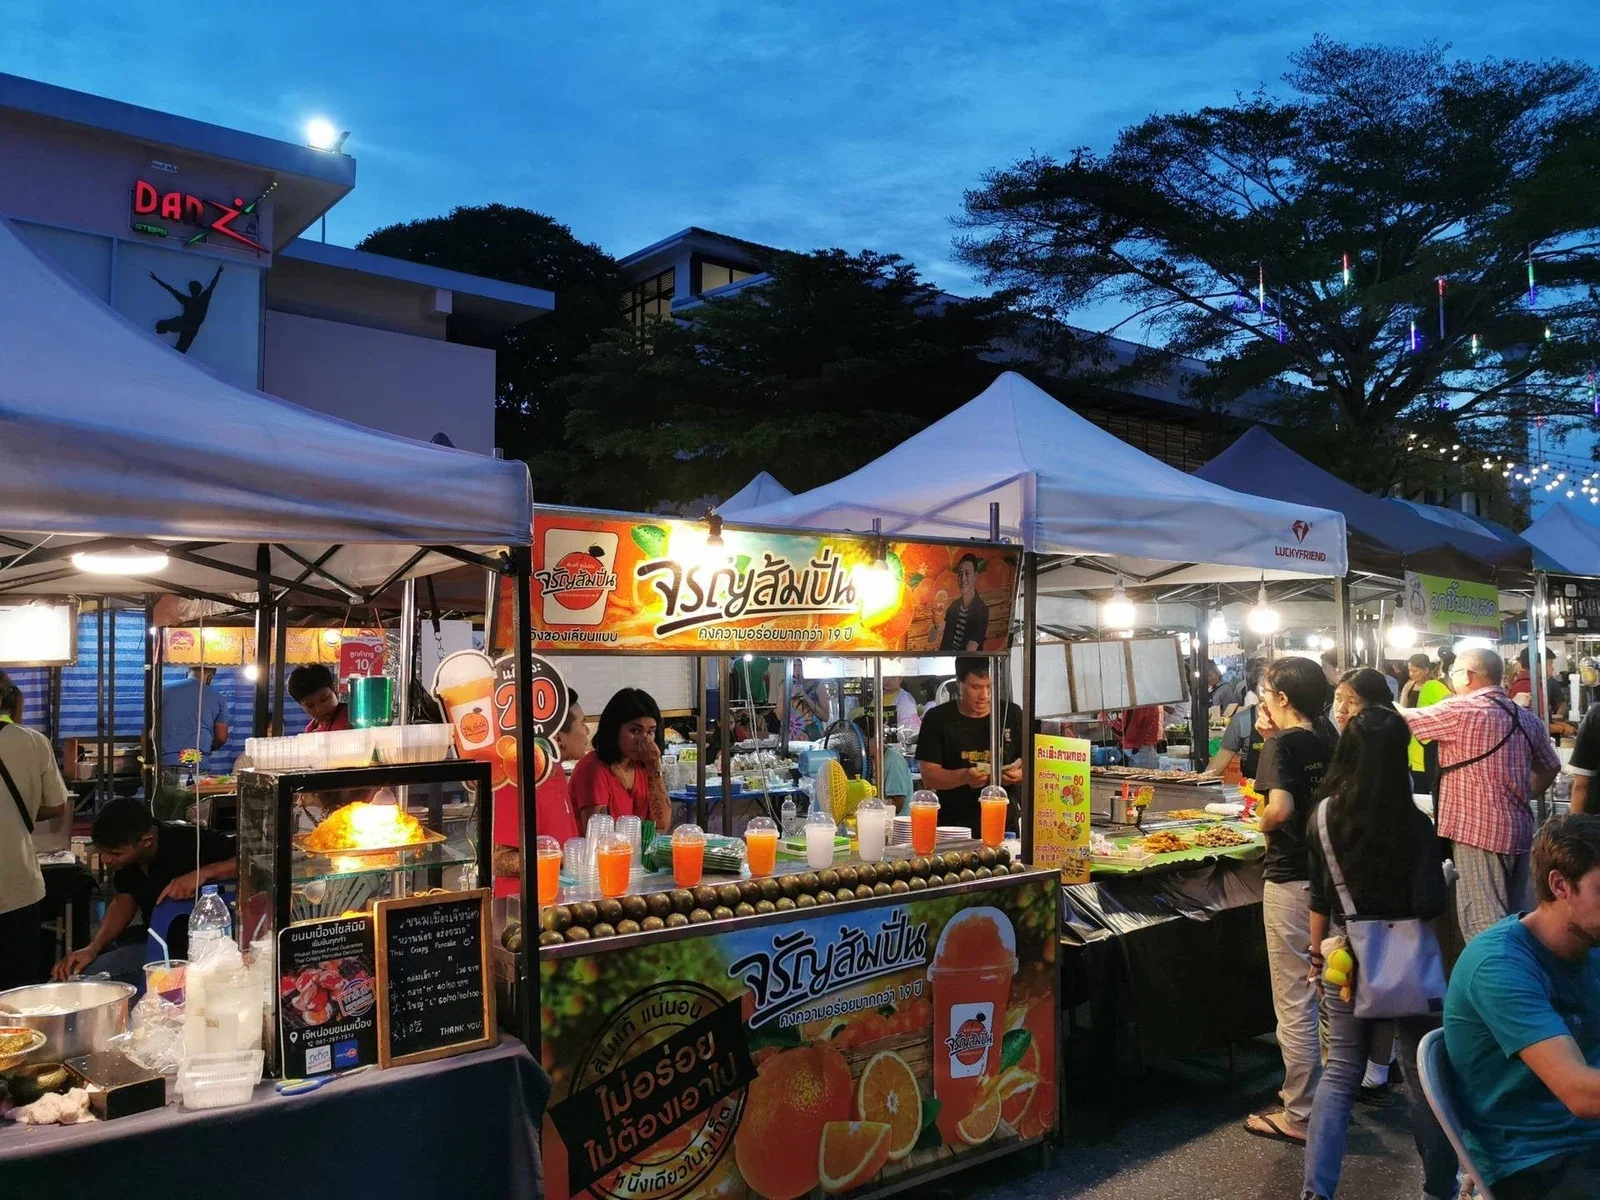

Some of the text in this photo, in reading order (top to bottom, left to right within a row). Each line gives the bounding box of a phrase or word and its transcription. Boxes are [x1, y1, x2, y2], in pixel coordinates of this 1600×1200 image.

[134, 223, 168, 237] STEPS
[1275, 546, 1326, 561] LUCKYFRIEND
[536, 567, 615, 592] จรัญส้มปั่น
[637, 549, 857, 619] จรญส้มปั่น
[531, 628, 618, 642] วังของเลียนแบบ
[699, 624, 853, 641] คงความอร่อยมากกว่า 19 ปี
[355, 660, 370, 671] 10
[1074, 775, 1084, 786] 60
[1075, 812, 1086, 823] 60
[291, 920, 366, 942] ขนมเบื้องไซส์มินิ
[410, 946, 429, 954] Crispy
[729, 910, 926, 1007] จรัญส้มปั่น
[641, 995, 703, 1025] แน่นอน
[780, 980, 923, 1028] คงความอร่อยมากกว่า 19 ปี
[440, 1024, 465, 1036] THANK
[595, 1030, 716, 1121] ไม่อร่อย
